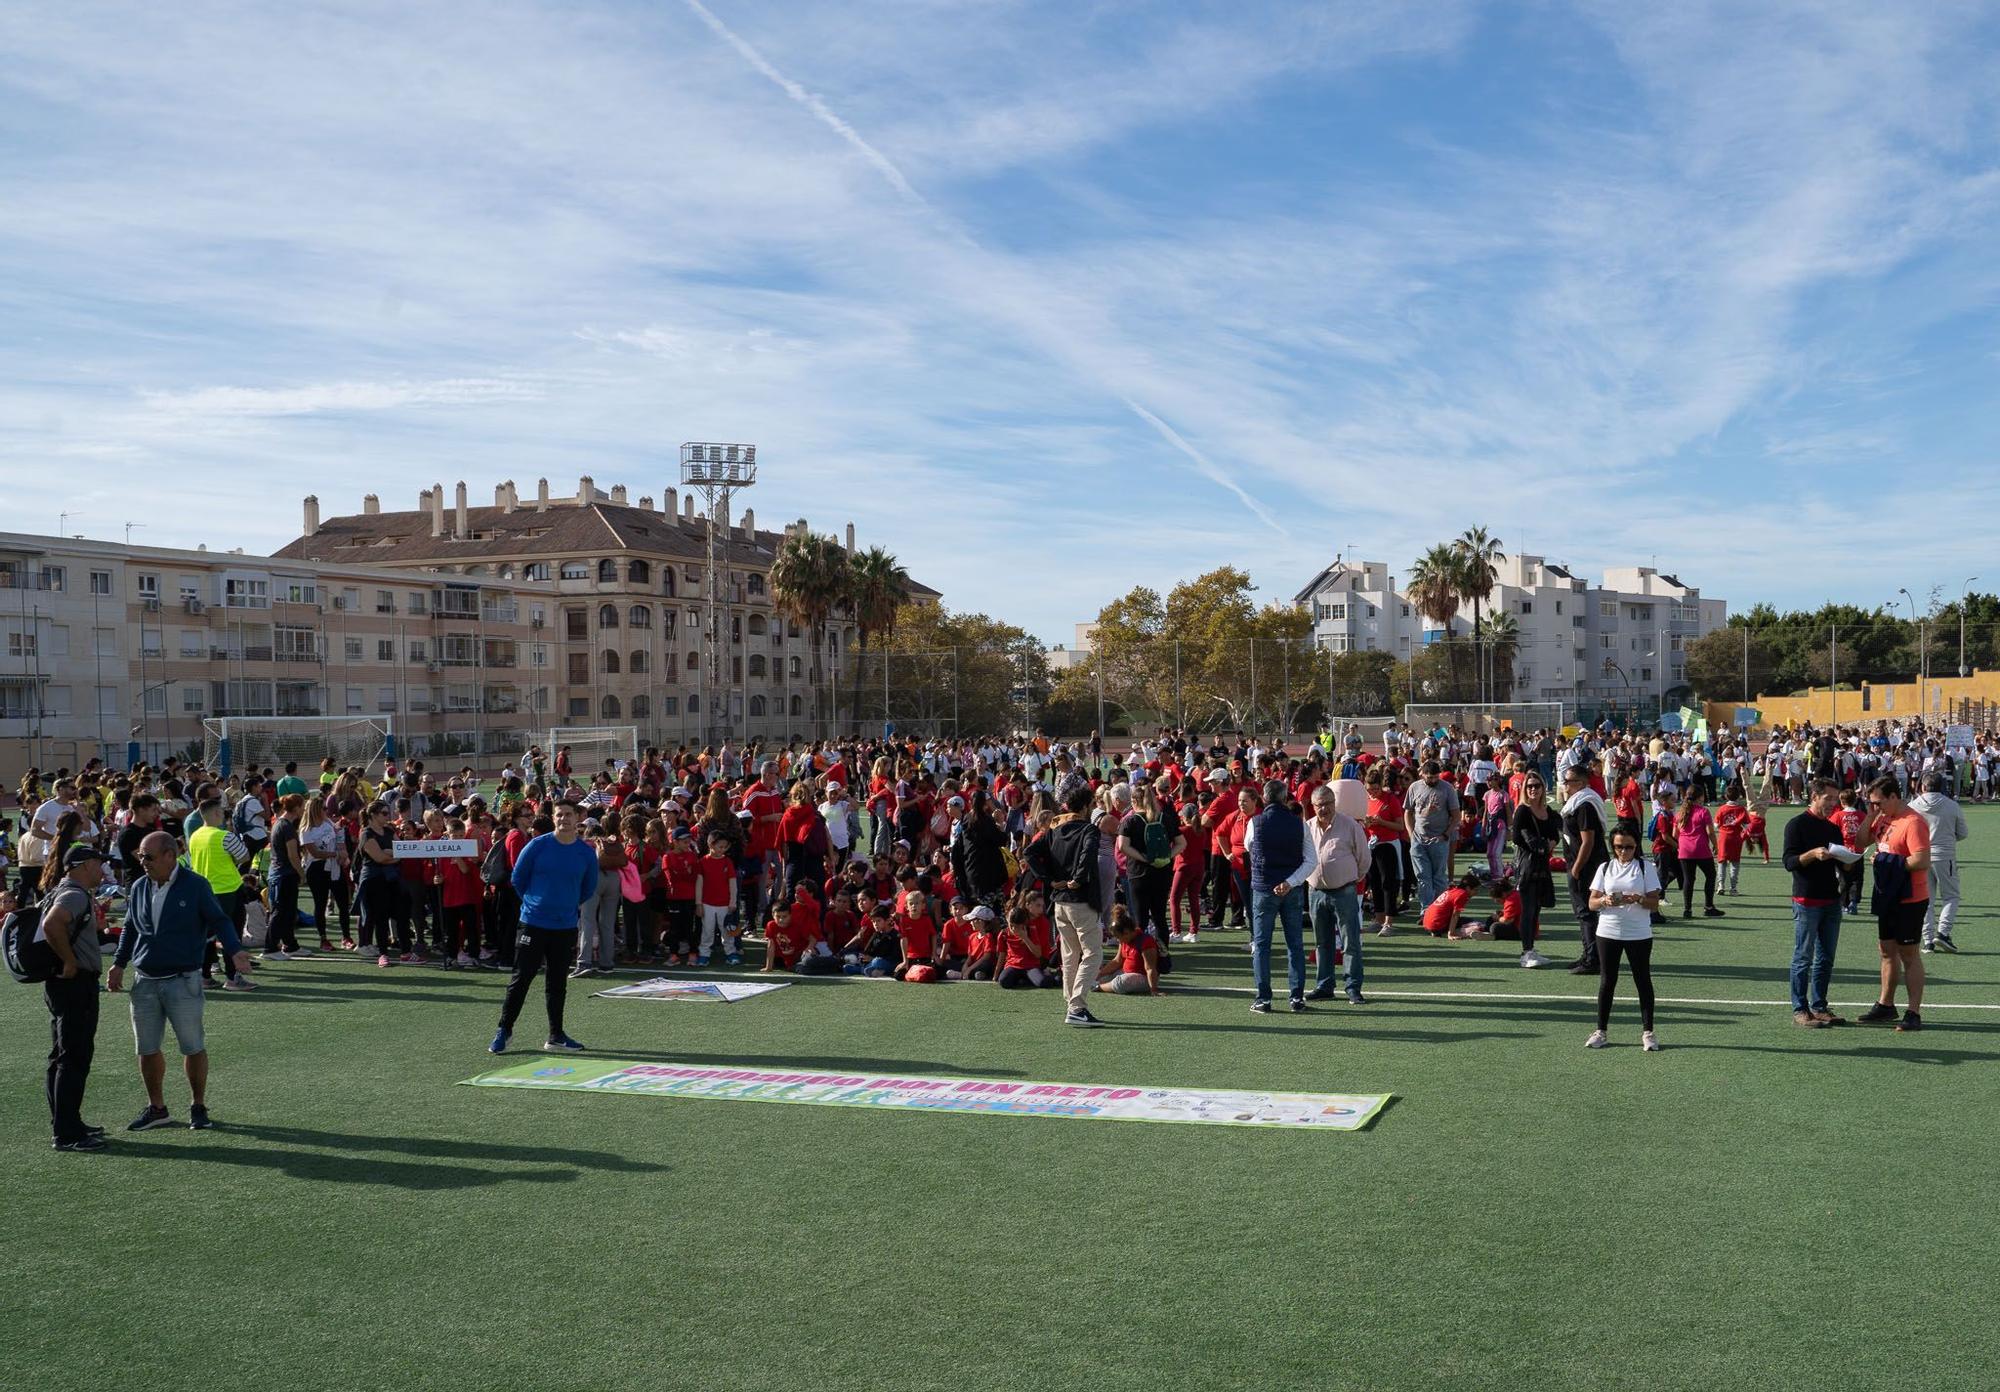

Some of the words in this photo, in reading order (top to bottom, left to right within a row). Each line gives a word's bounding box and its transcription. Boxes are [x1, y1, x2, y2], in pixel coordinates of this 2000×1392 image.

[438, 844, 461, 852] LEALA
[954, 1081, 1024, 1095] UN
[1025, 1086, 1143, 1100] RETO
